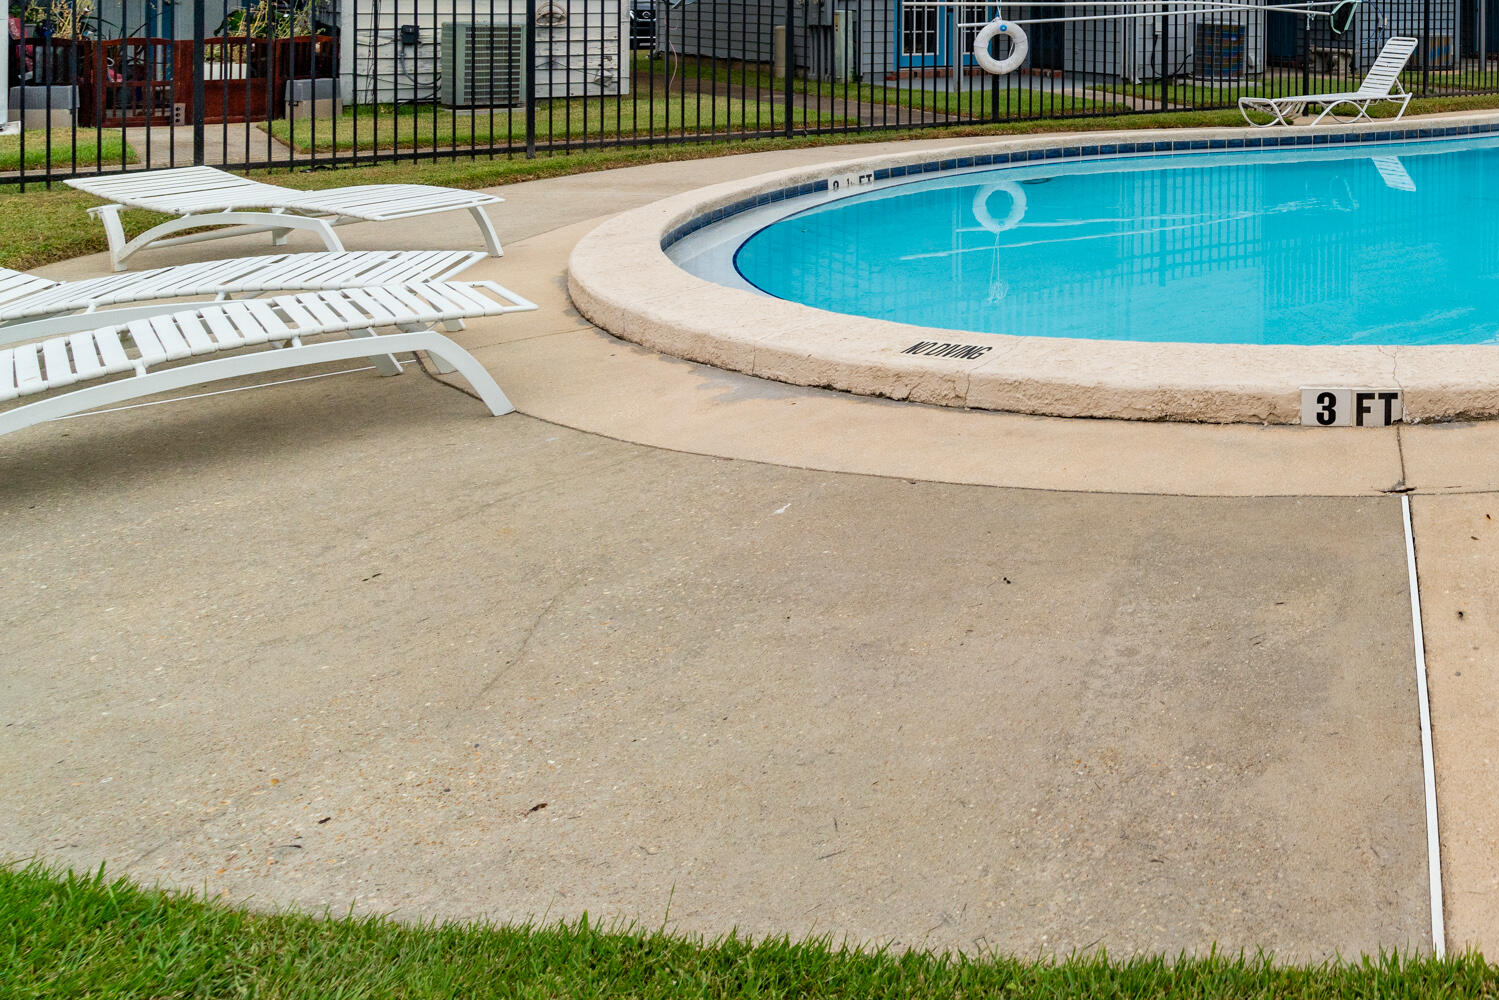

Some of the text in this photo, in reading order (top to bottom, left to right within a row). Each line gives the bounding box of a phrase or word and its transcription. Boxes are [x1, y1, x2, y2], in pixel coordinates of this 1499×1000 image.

[900, 342, 992, 360] NO DIVING
[1316, 392, 1398, 426] 3 FT
